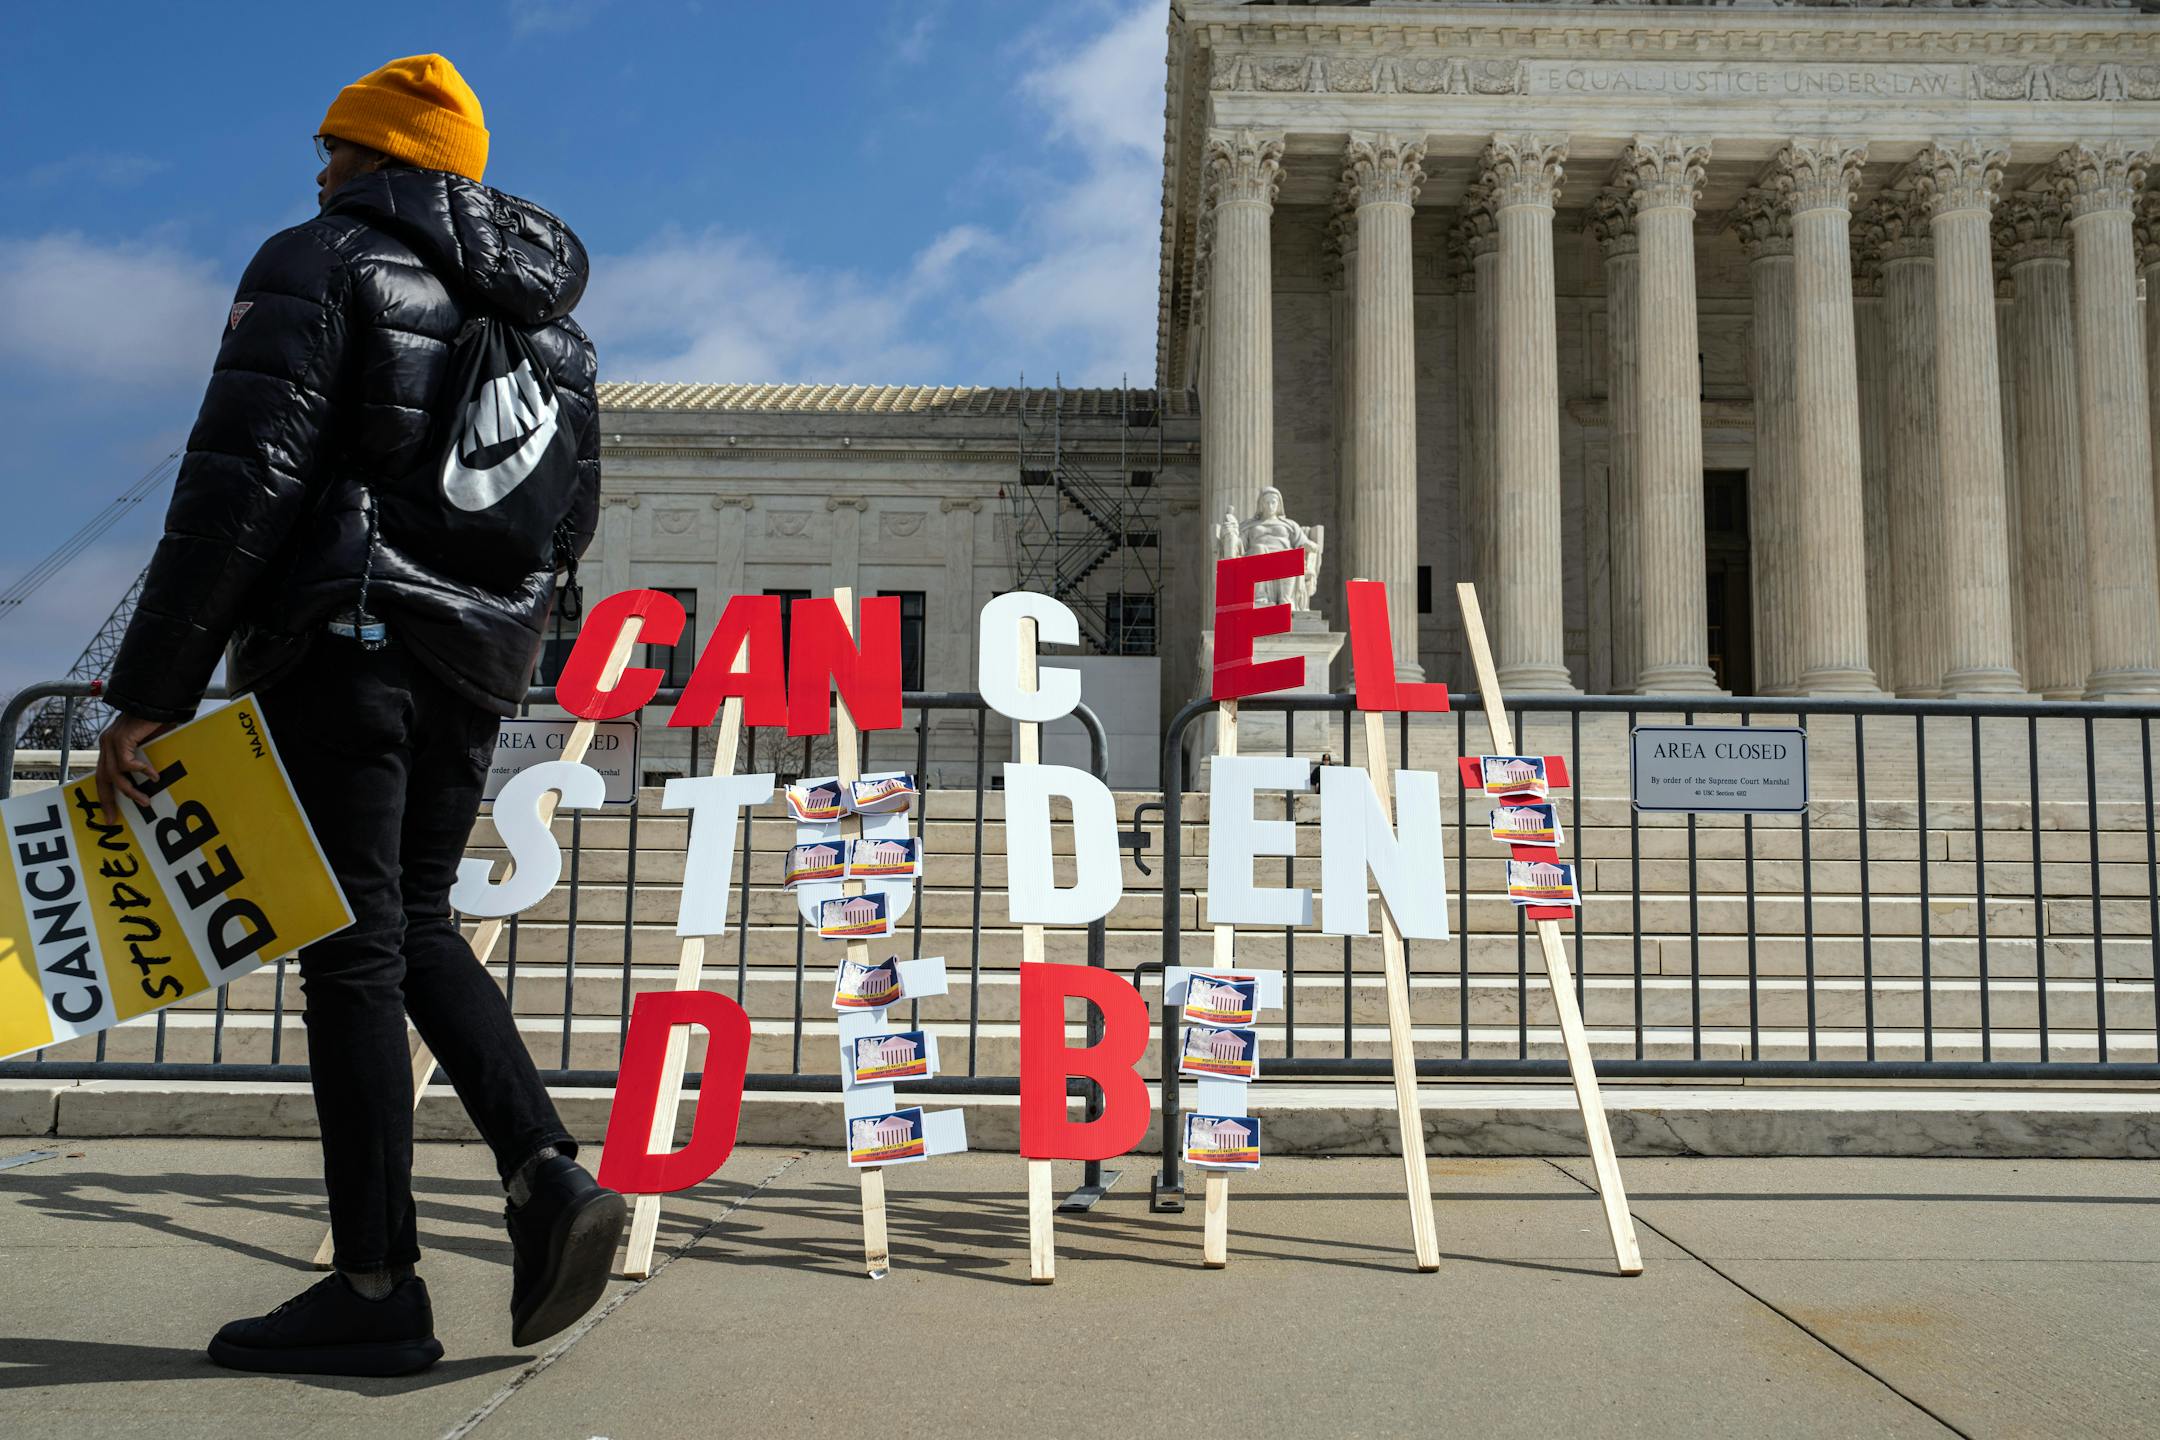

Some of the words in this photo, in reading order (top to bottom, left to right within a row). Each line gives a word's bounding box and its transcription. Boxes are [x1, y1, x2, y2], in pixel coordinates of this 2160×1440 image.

[1549, 69, 1648, 92] EQUAL
[1655, 71, 1769, 93] JUSTICE
[1783, 71, 1883, 96] UNDER
[1893, 72, 1949, 94] LAW
[238, 711, 266, 759] NAACP
[499, 732, 537, 749] REA
[1653, 742, 1706, 759] AREA
[1715, 743, 1787, 760] CLOSED
[597, 768, 621, 776] arshal
[1651, 776, 1660, 785] By
[1663, 776, 1681, 784] order
[1684, 776, 1693, 784] of
[1695, 776, 1706, 785] the
[1708, 777, 1738, 787] Supreme
[1740, 777, 1760, 785] Court
[1762, 778, 1790, 786] Marshal
[127, 759, 278, 971] DEBT
[74, 786, 185, 999] STUDENT
[14, 804, 103, 1023] CANCEL
